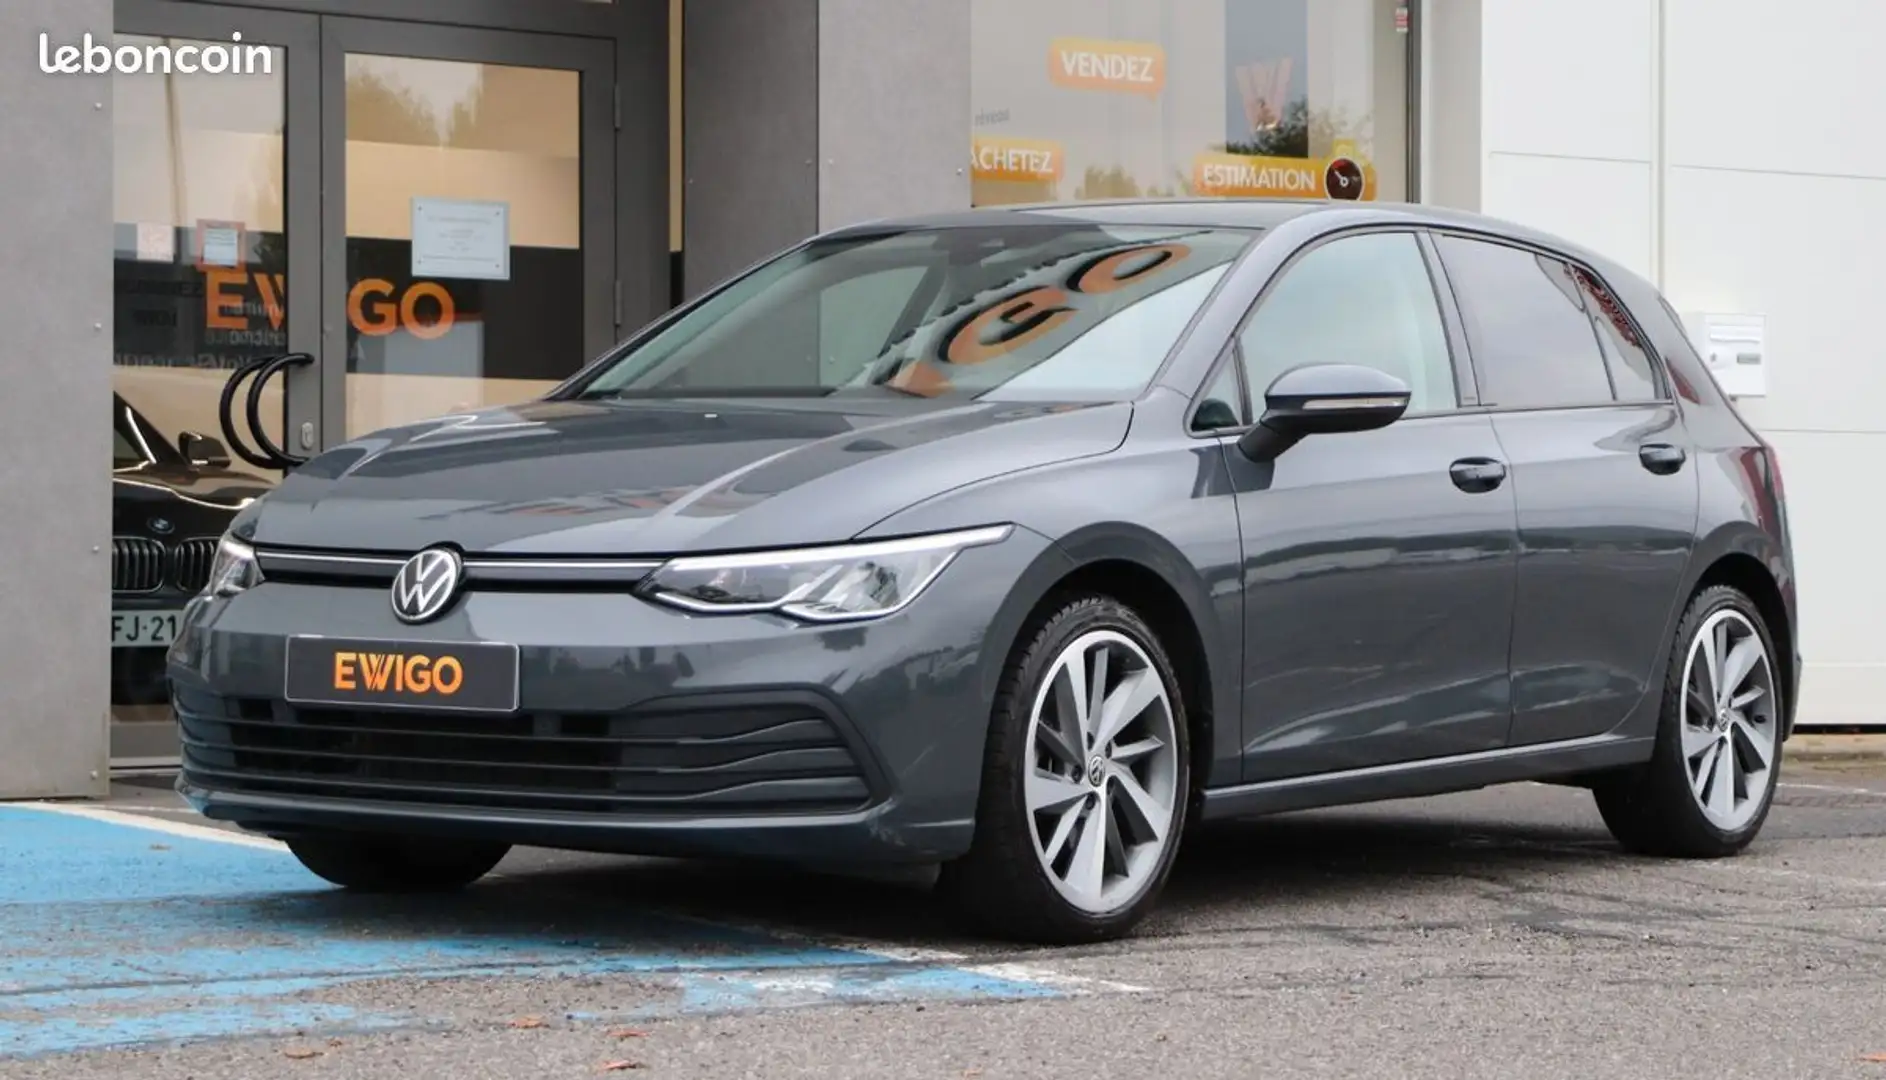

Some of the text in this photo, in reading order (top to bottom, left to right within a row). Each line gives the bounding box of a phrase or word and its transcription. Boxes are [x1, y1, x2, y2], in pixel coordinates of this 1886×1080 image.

[1060, 50, 1155, 83] VENDEZ
[1202, 163, 1317, 192] ESTIMATION
[333, 651, 463, 695] EWIGO
